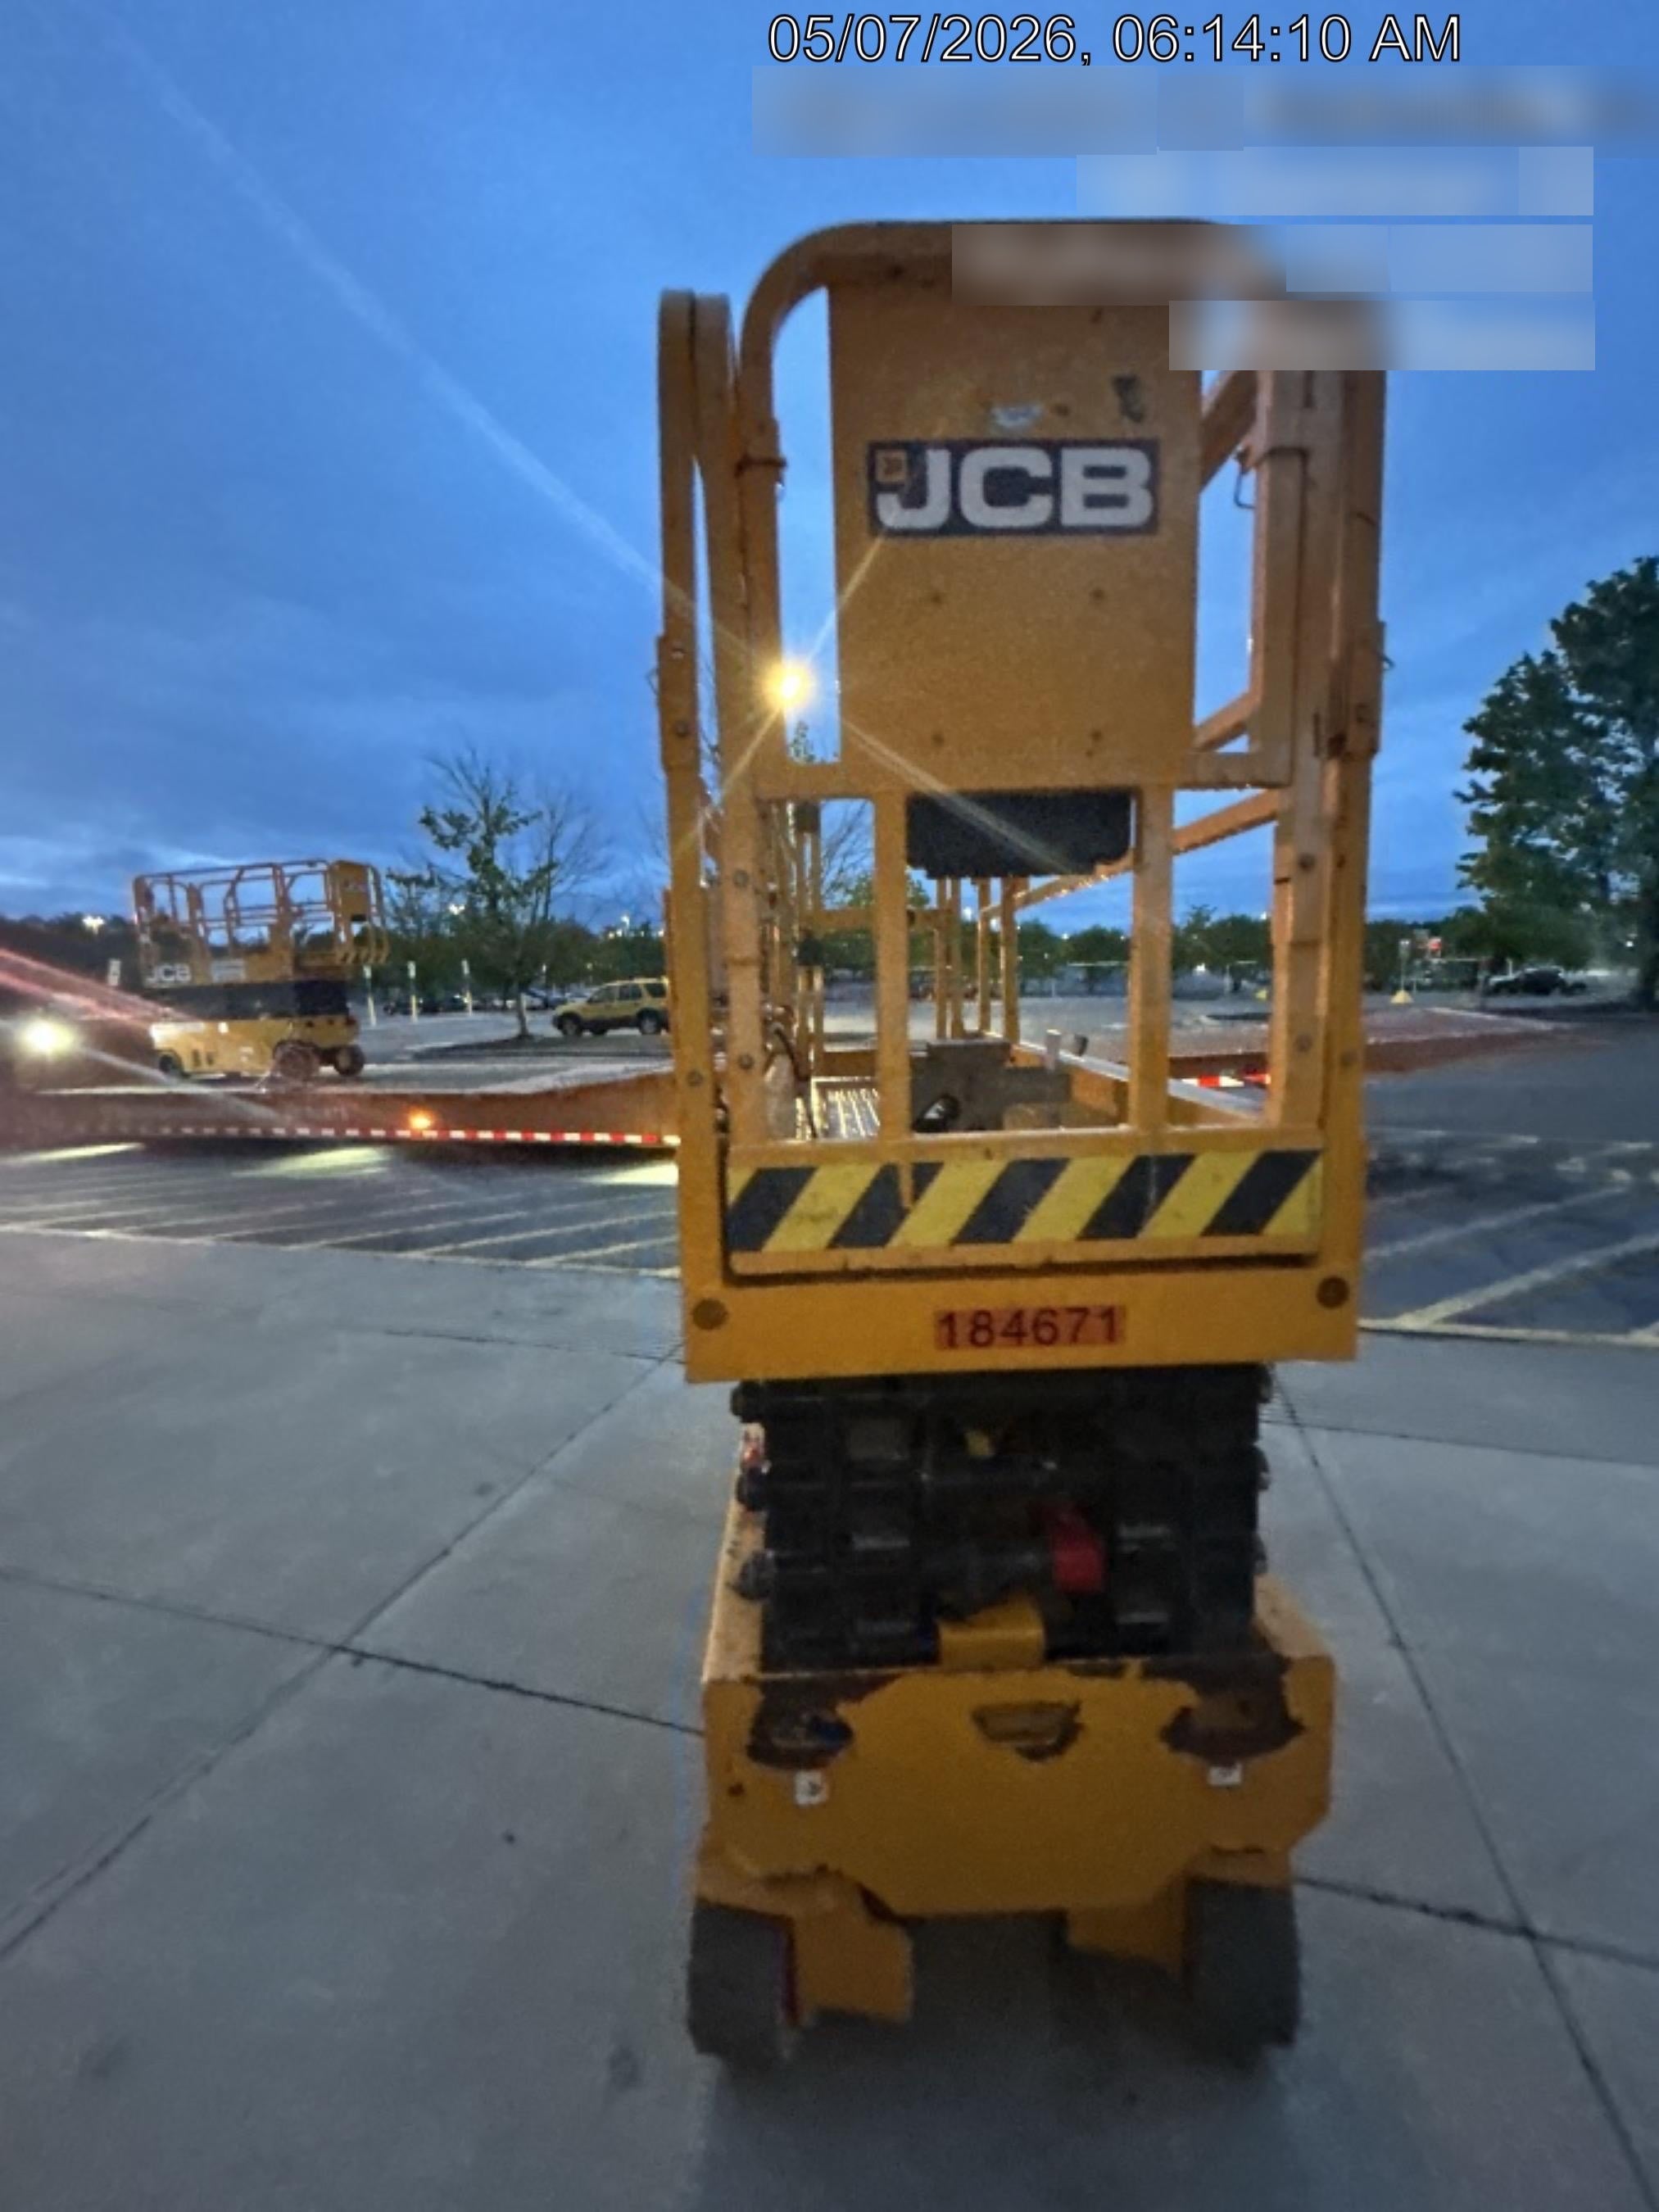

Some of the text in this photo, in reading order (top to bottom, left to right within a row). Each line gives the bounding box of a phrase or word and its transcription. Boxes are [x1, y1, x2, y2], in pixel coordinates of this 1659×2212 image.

[876, 446, 1154, 529] JCB
[145, 963, 191, 982] JCB
[938, 1307, 1117, 1349] 184671
